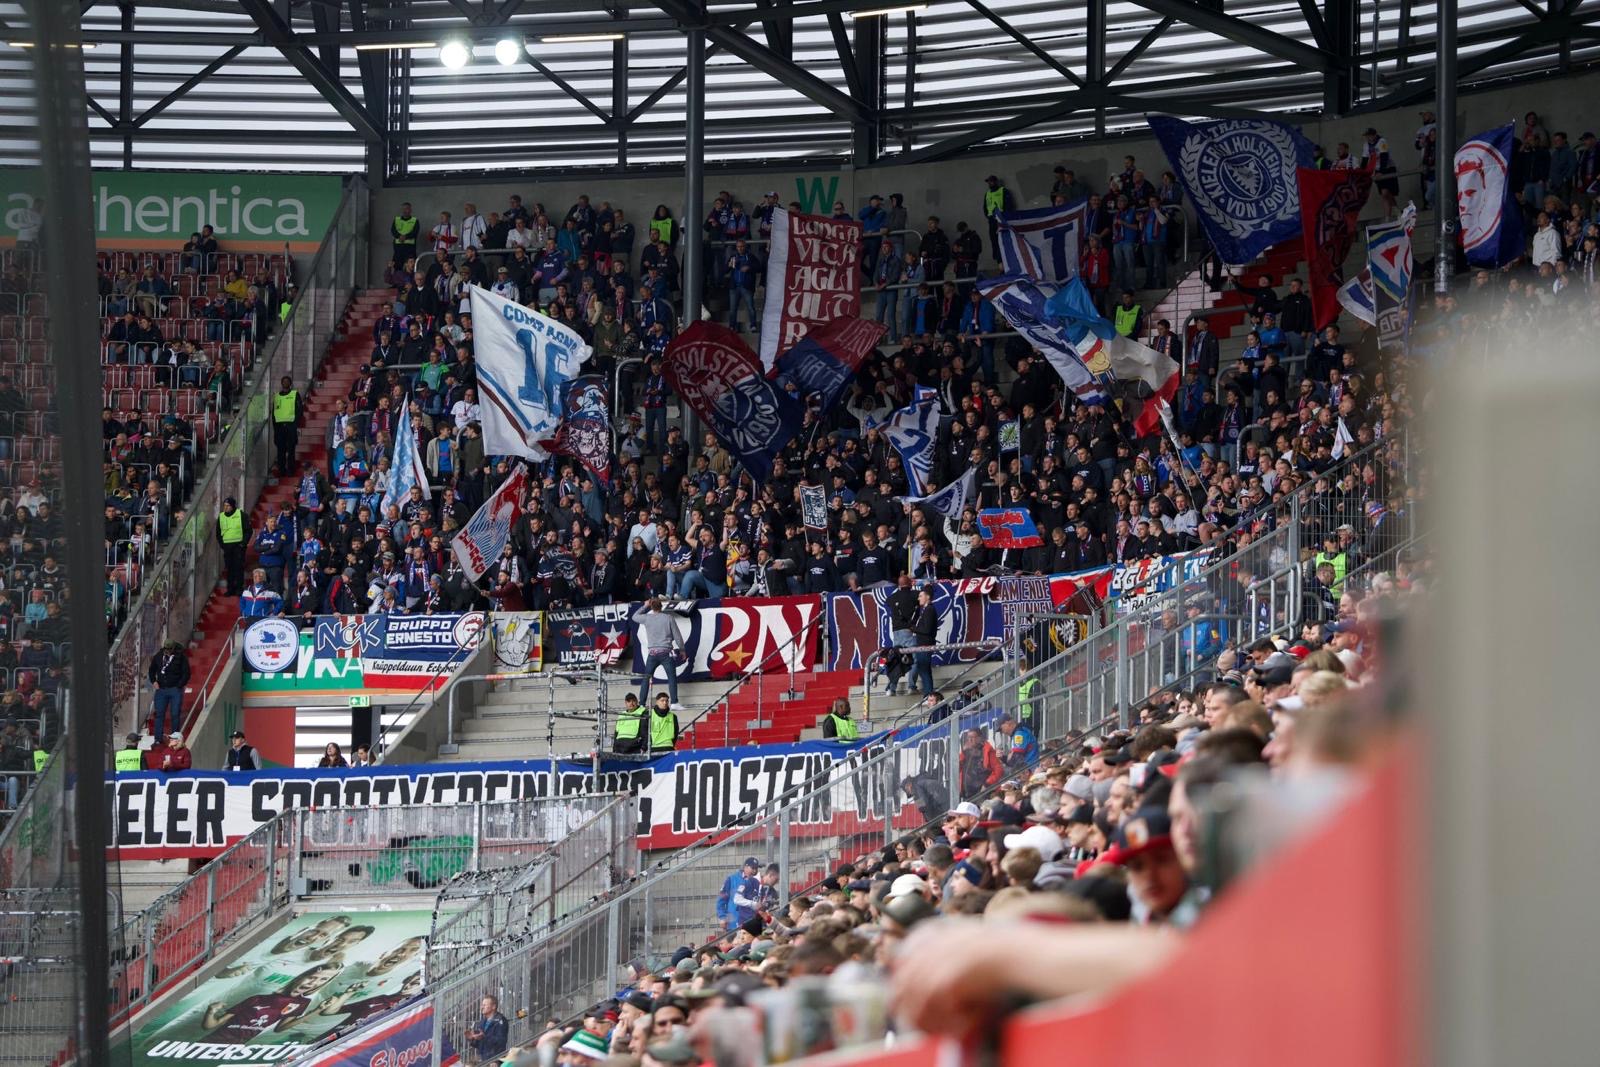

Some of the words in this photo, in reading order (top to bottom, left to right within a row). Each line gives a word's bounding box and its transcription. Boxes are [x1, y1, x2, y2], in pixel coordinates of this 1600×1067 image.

[796, 176, 839, 214] W
[1226, 197, 1257, 218] VON
[1259, 183, 1287, 214] 1900
[788, 265, 854, 291] AGLI
[1021, 580, 1050, 600] ENDE
[317, 618, 380, 653] NCK
[386, 632, 452, 645] ERNESTO
[388, 620, 451, 631] GRUPPO
[672, 751, 832, 831] HOLSTEIN
